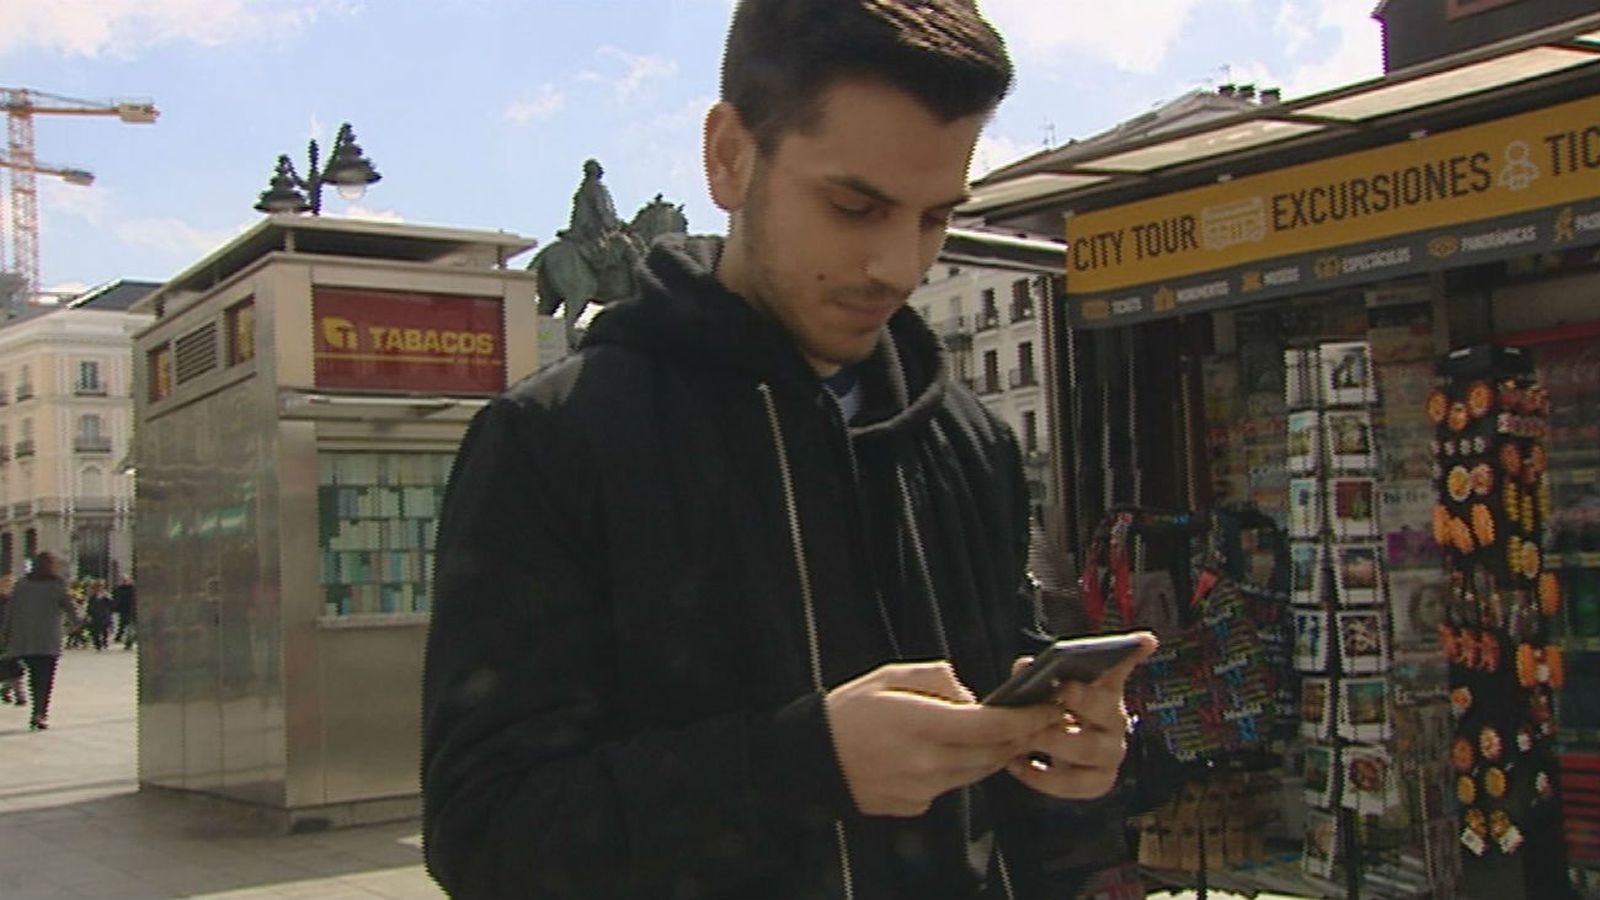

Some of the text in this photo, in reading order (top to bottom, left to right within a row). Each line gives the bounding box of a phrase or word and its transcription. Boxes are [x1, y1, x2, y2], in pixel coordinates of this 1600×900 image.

[1073, 125, 1600, 271] CITY TOUR EXCURSIONES TIC
[368, 326, 494, 354] TABACOS
